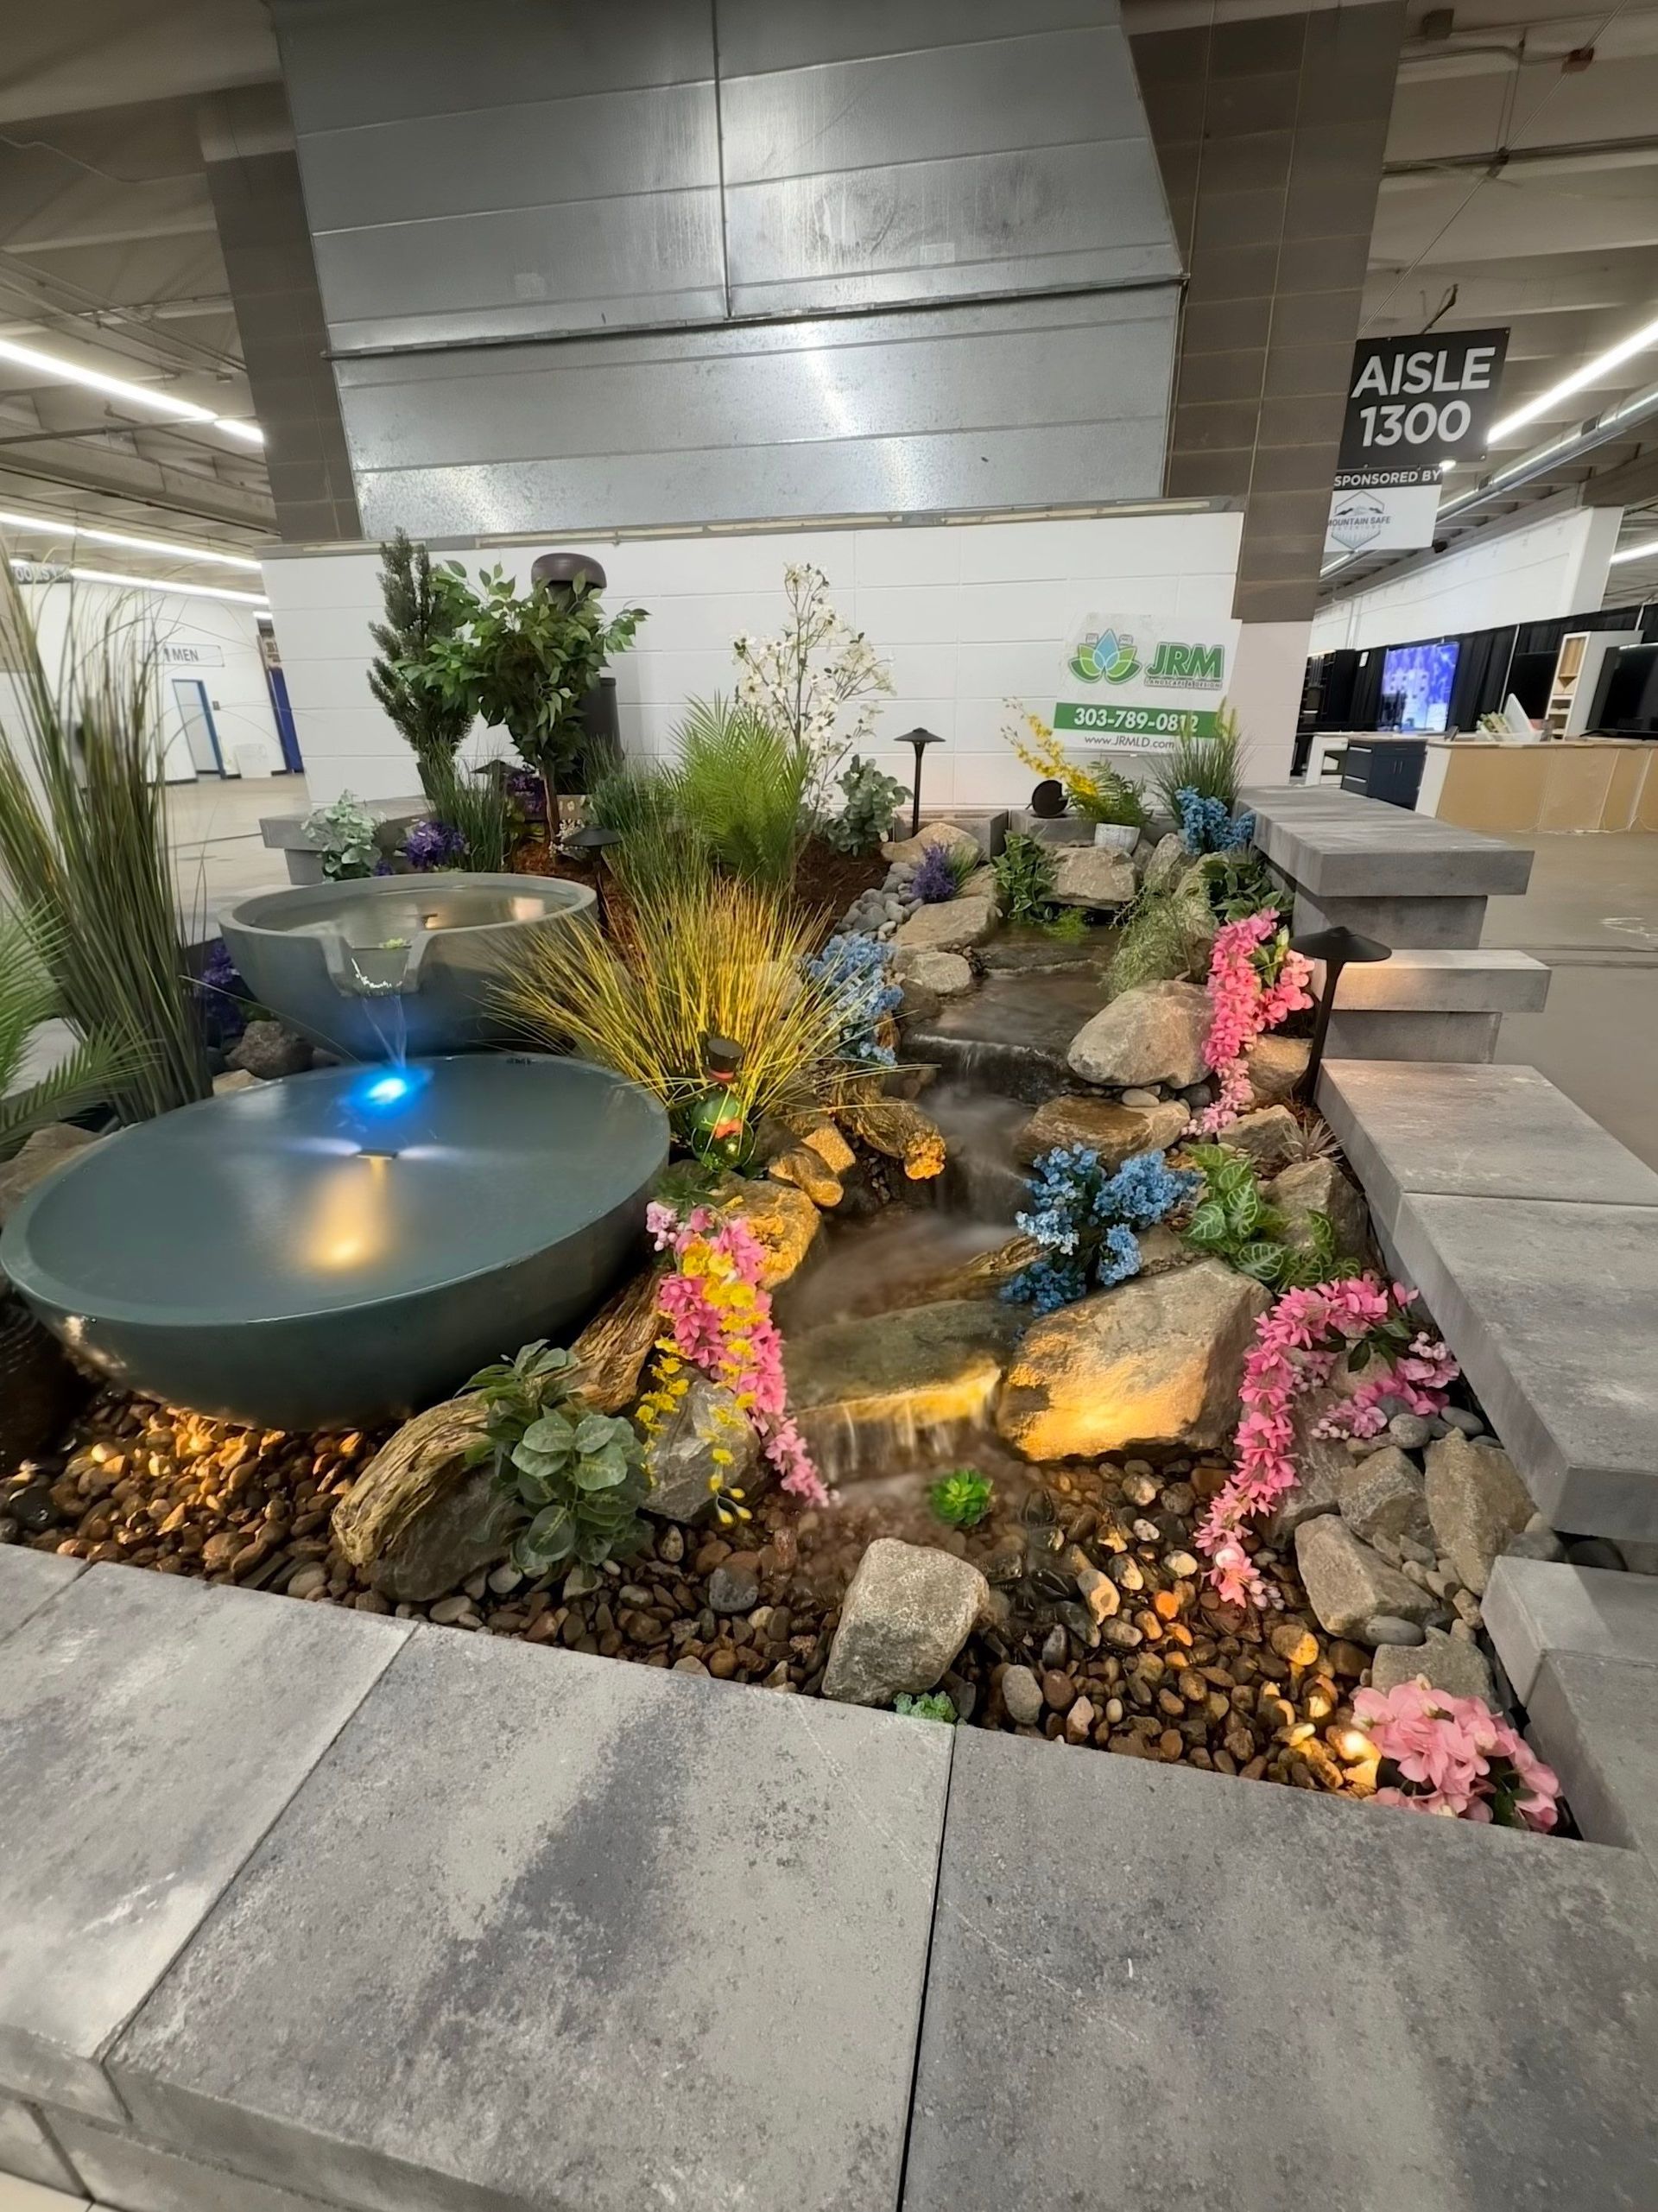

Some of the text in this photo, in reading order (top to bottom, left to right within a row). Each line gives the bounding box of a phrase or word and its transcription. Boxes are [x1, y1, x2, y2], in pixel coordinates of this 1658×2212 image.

[1351, 346, 1496, 398] AISLE
[1360, 400, 1471, 447] 1300
[1334, 470, 1441, 486] SPONSORED BY
[172, 648, 199, 662] MEN
[1145, 643, 1224, 680] JRM
[1073, 707, 1199, 732] 303-789-0812
[1085, 736, 1175, 749] www.JRMLD.com
